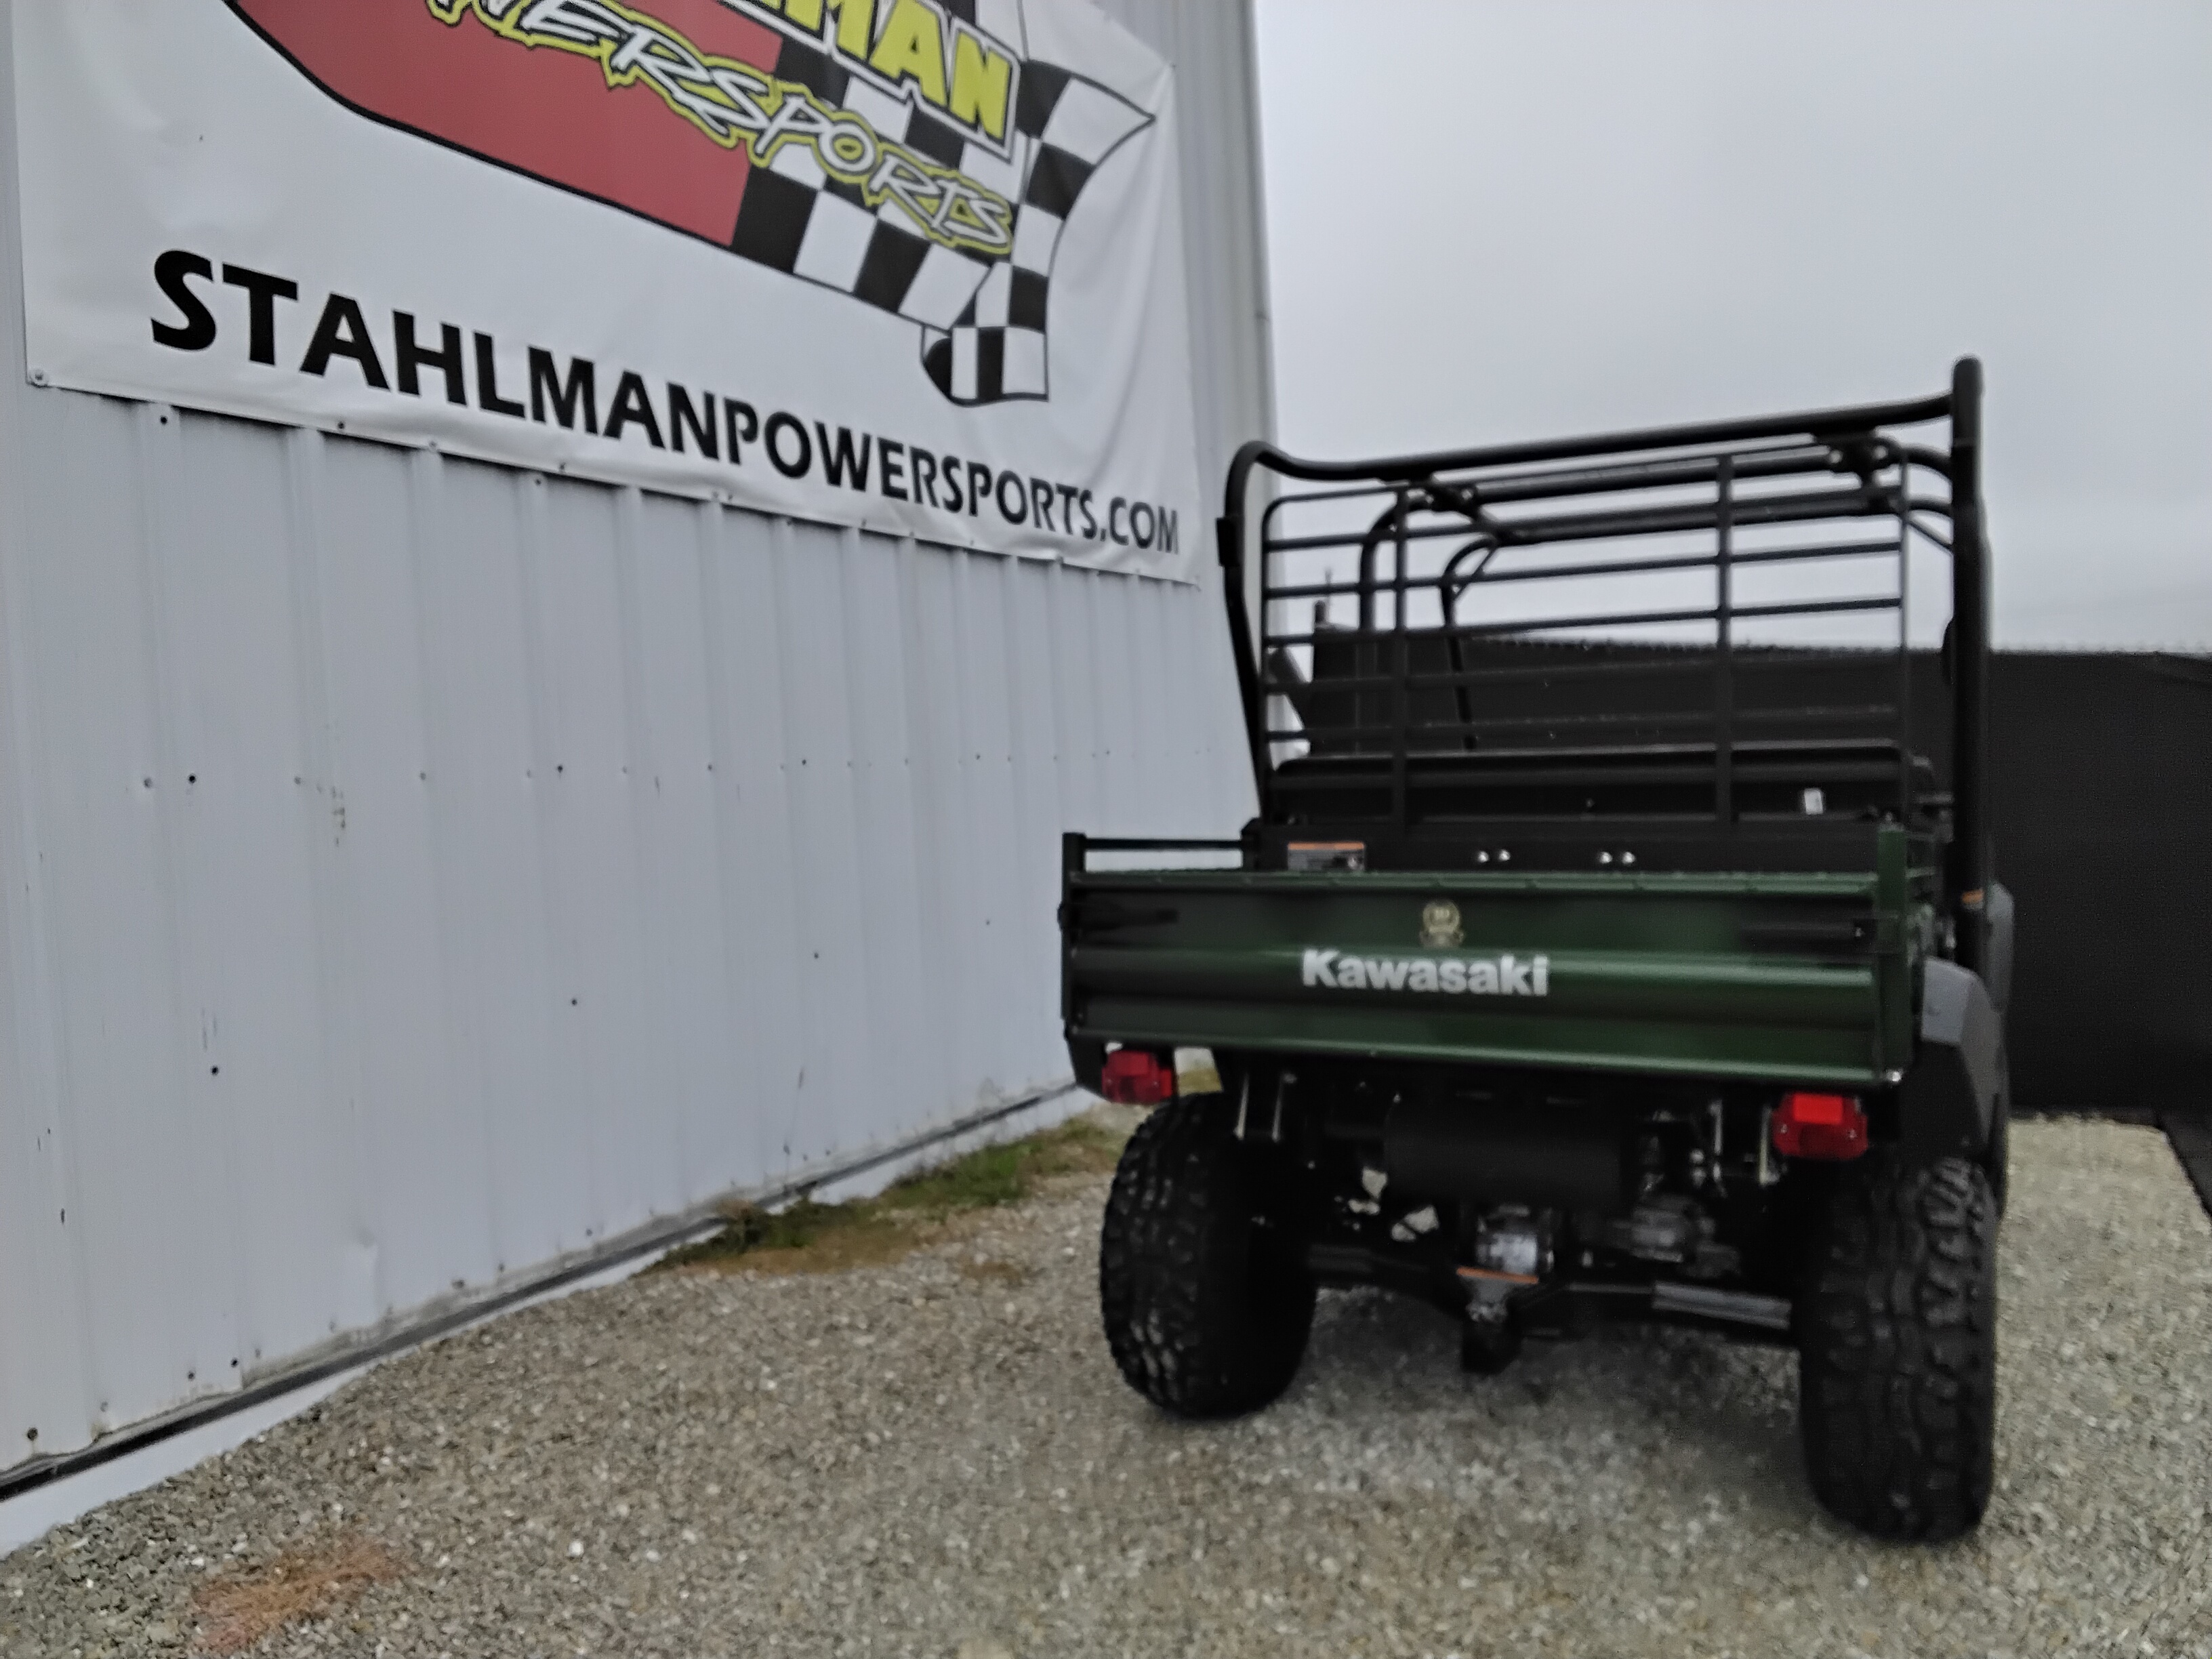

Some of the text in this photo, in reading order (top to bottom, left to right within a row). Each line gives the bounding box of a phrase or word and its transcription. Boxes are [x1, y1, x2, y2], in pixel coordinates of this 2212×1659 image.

[432, 0, 1011, 251] ERSPORTS
[748, 0, 1014, 150] MAN
[150, 249, 1179, 555] STAHLMANPOWERSPORTS.COM
[1301, 947, 1551, 998] Kawasaki
